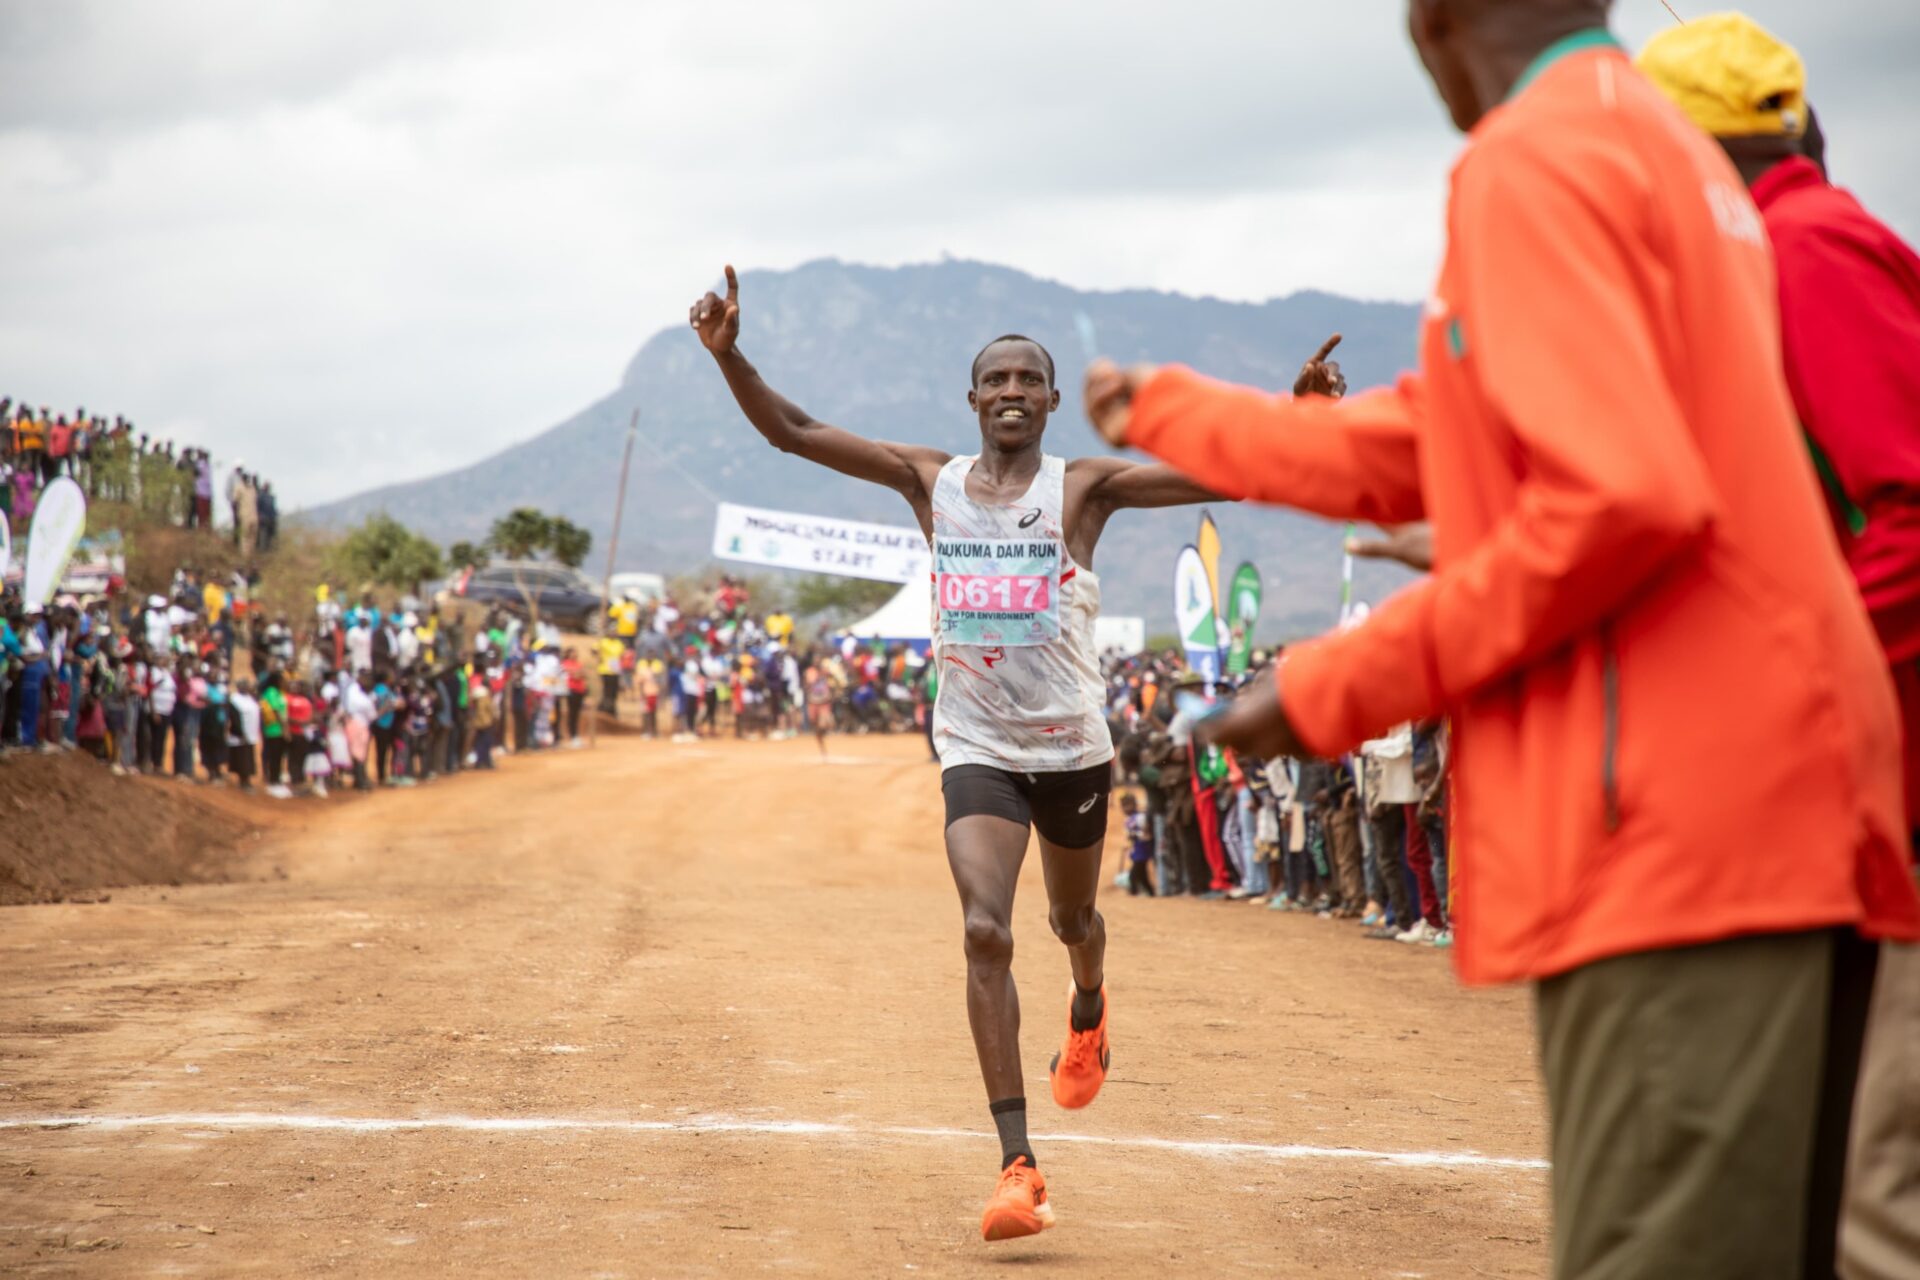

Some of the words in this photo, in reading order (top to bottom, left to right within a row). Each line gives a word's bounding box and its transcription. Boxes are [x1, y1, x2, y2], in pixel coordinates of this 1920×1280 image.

[855, 529, 902, 549] DAM
[811, 547, 875, 569] START
[996, 544, 1024, 558] DAM
[1028, 543, 1057, 558] RUN
[945, 576, 1042, 609] 0617
[961, 611, 976, 619] FOR
[977, 612, 1036, 620] ENVIRONMENT
